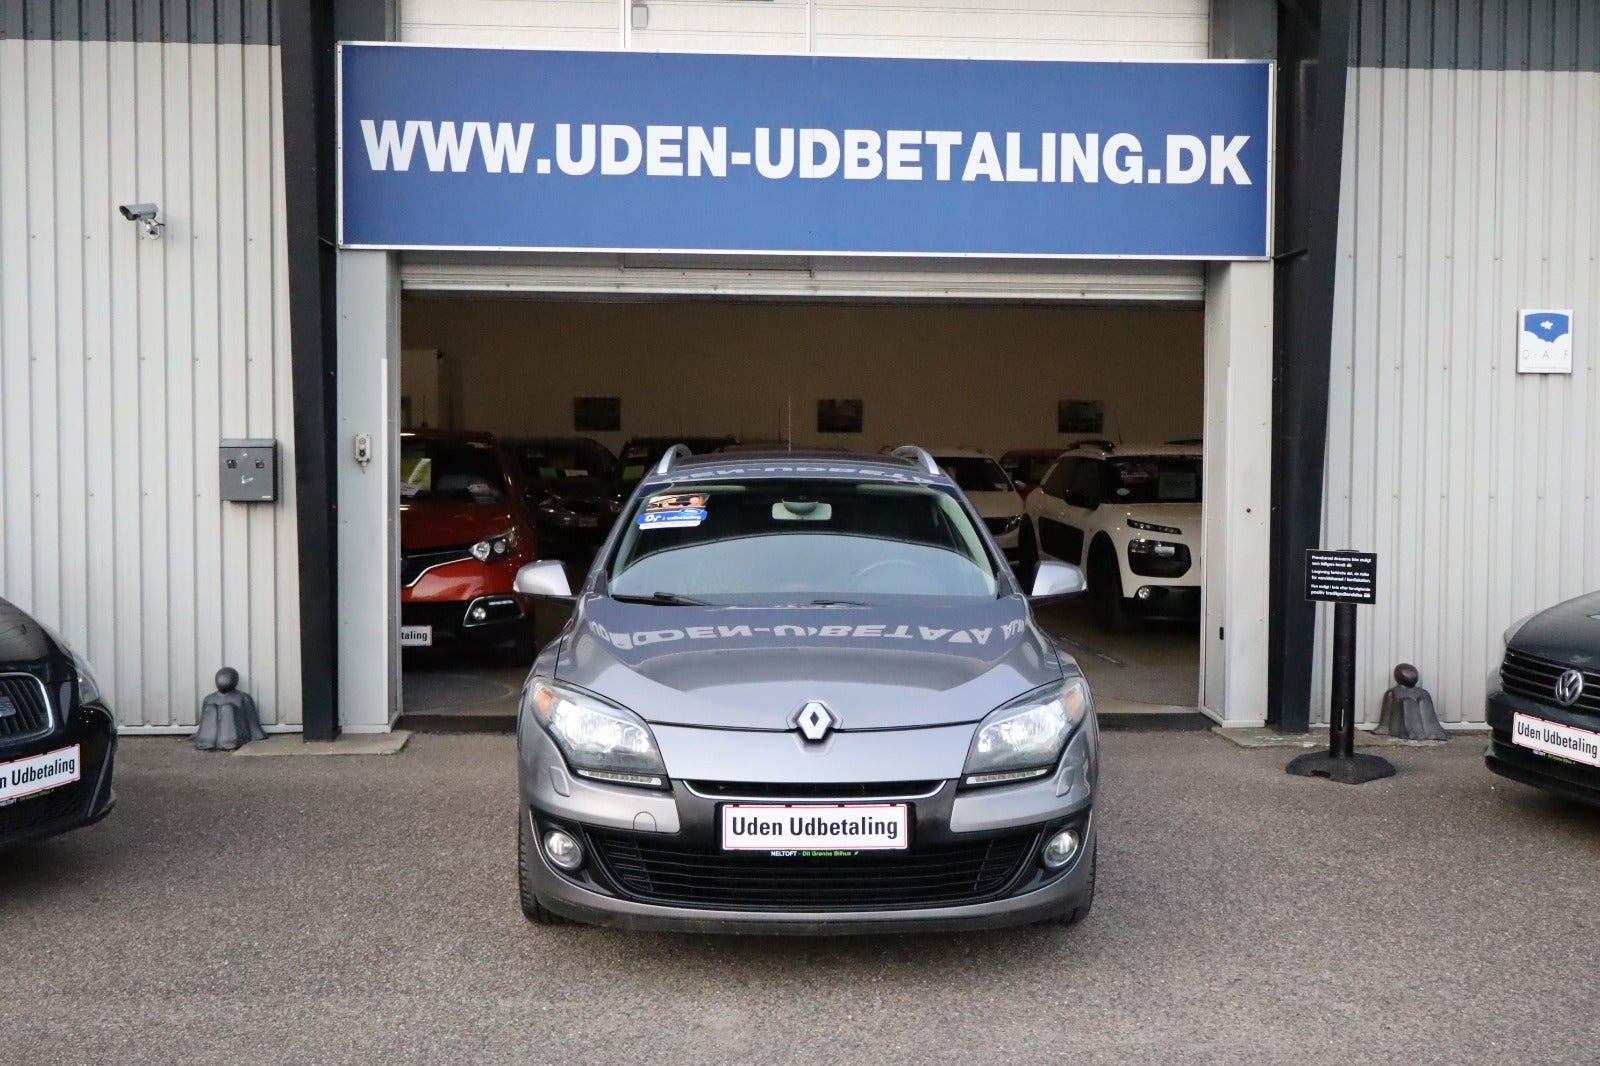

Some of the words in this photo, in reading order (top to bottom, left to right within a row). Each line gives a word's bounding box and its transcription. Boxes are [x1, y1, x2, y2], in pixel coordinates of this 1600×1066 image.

[360, 119, 1253, 186] WWW.UDEN-UDBETALING.DK
[1517, 721, 1541, 741] Uden
[1543, 728, 1598, 759] Udbetaling
[11, 758, 75, 786] Udbetaling
[732, 816, 783, 836] Uden
[790, 816, 898, 840] Udbetaling
